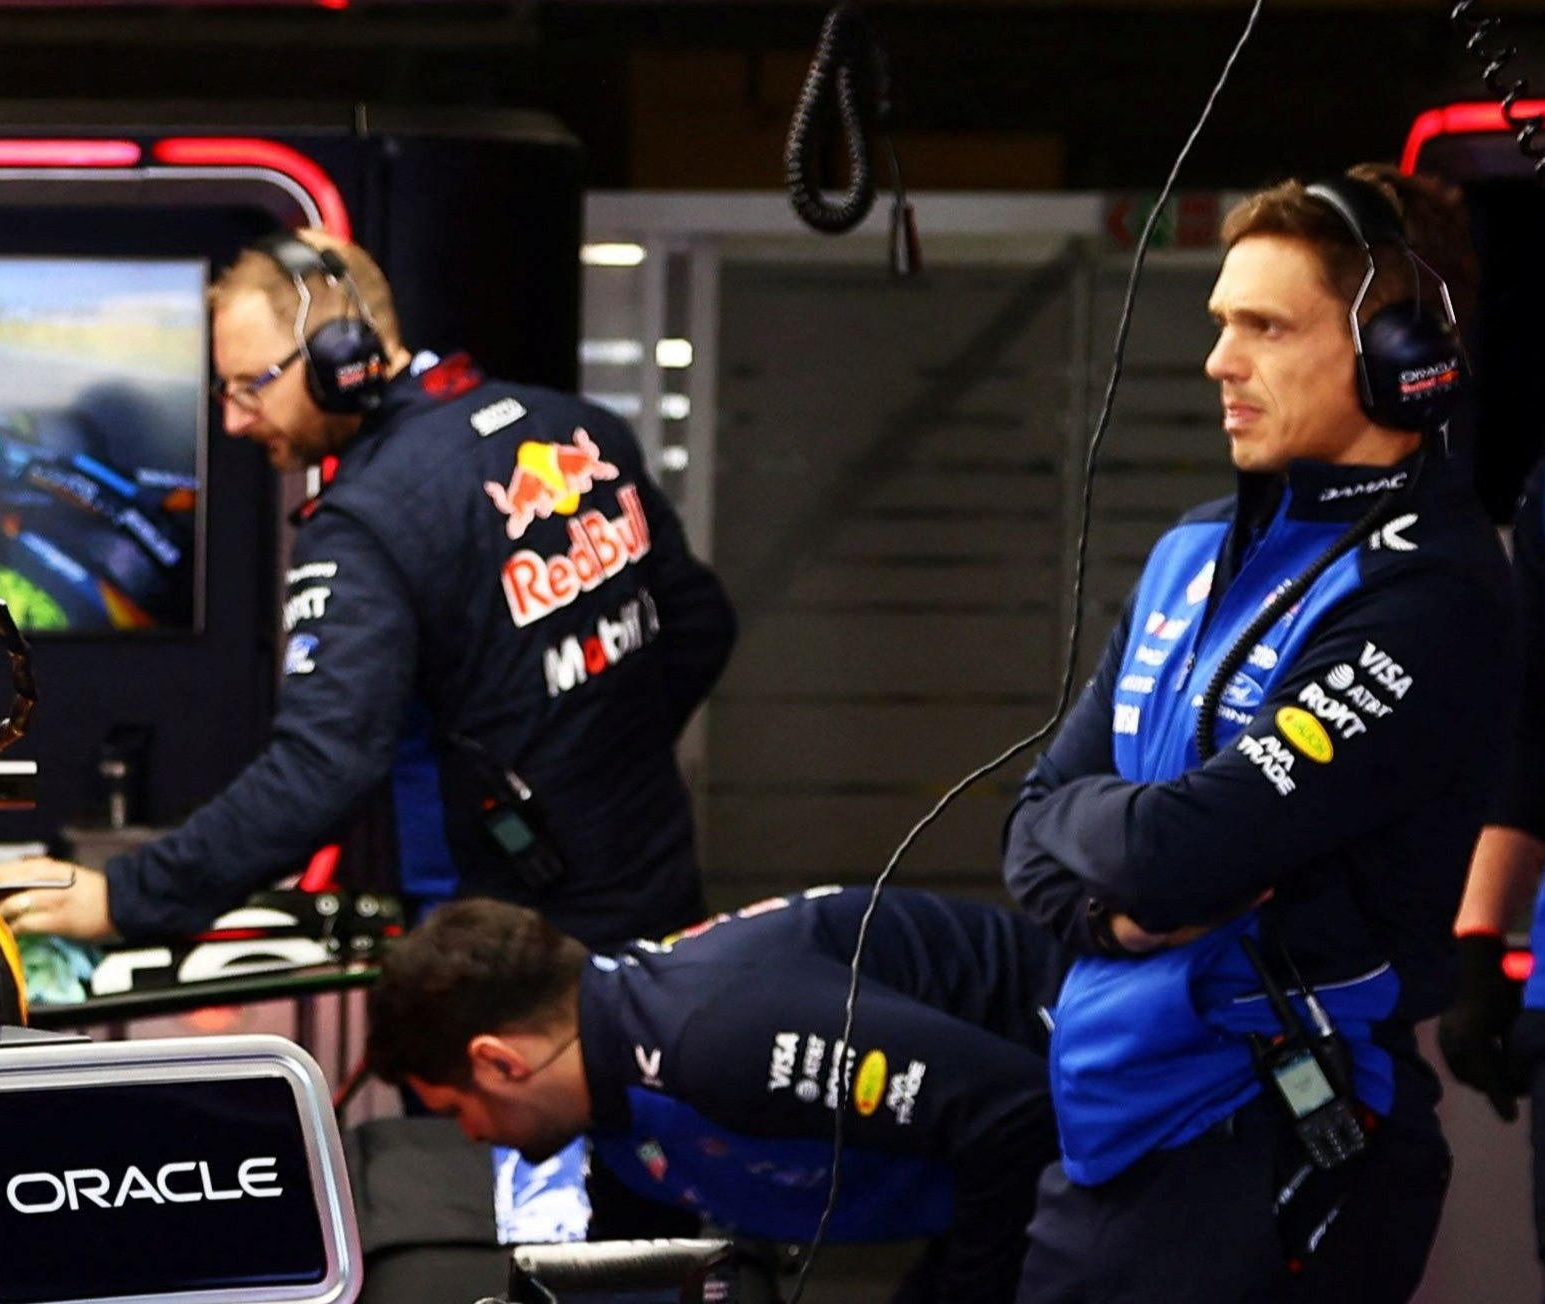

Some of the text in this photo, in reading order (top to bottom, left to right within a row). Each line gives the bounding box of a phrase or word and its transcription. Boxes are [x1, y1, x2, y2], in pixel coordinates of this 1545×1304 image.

[1359, 640, 1414, 700] VISA
[1298, 682, 1367, 740] ROKT
[5, 1156, 284, 1215] ORACLE
